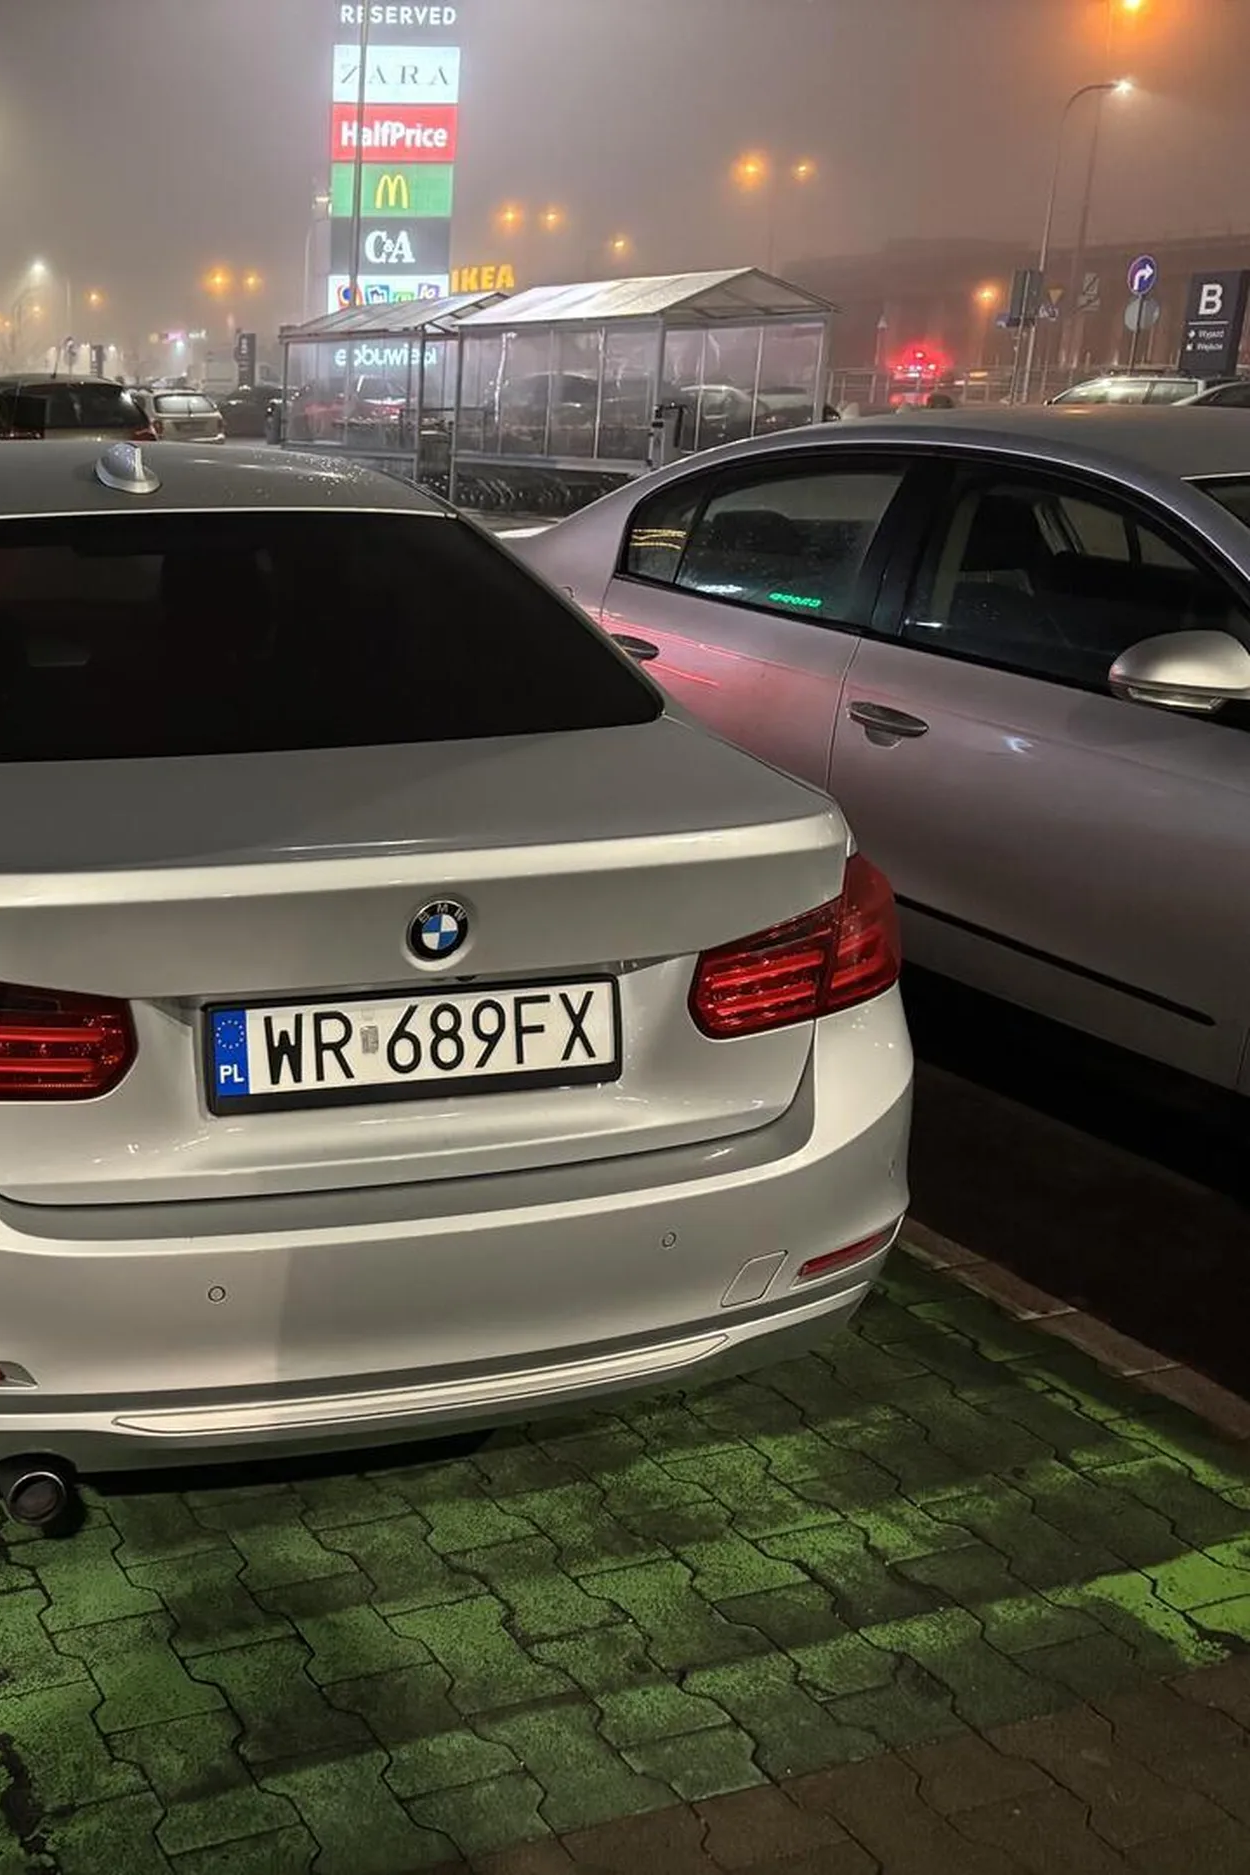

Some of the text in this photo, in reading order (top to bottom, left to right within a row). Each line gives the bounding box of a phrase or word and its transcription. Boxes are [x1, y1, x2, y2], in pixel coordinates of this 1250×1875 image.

[341, 4, 456, 25] RESERVED
[340, 64, 450, 85] ZARA
[341, 120, 448, 148] HalfPrice
[365, 230, 416, 264] C&A
[452, 264, 515, 293] IKEA
[1198, 284, 1223, 315] B
[418, 903, 468, 925] BMW
[263, 990, 597, 1086] WR 689FX
[219, 1064, 244, 1084] PL
